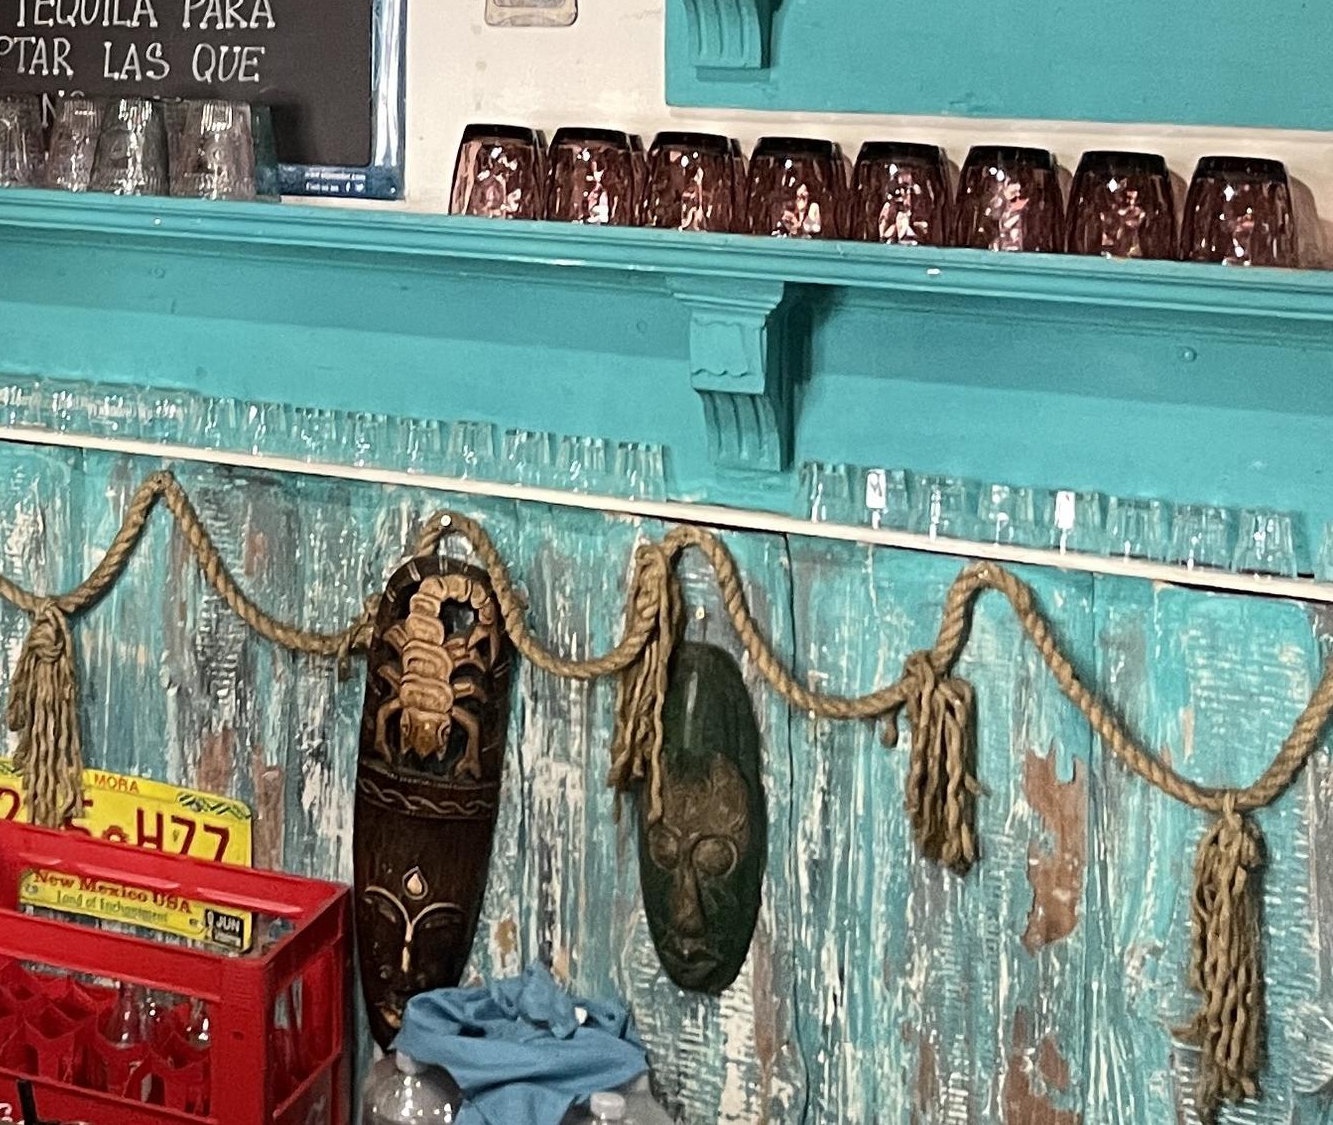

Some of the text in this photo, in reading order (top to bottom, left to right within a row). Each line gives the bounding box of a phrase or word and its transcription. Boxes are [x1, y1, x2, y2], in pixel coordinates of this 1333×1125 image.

[103, 41, 170, 81] LAS
[192, 42, 266, 83] QUE
[94, 773, 141, 794] MORA
[34, 870, 192, 914] New Mexico USA
[56, 889, 83, 909] Land
[85, 895, 97, 908] of
[215, 915, 242, 933] JUN
